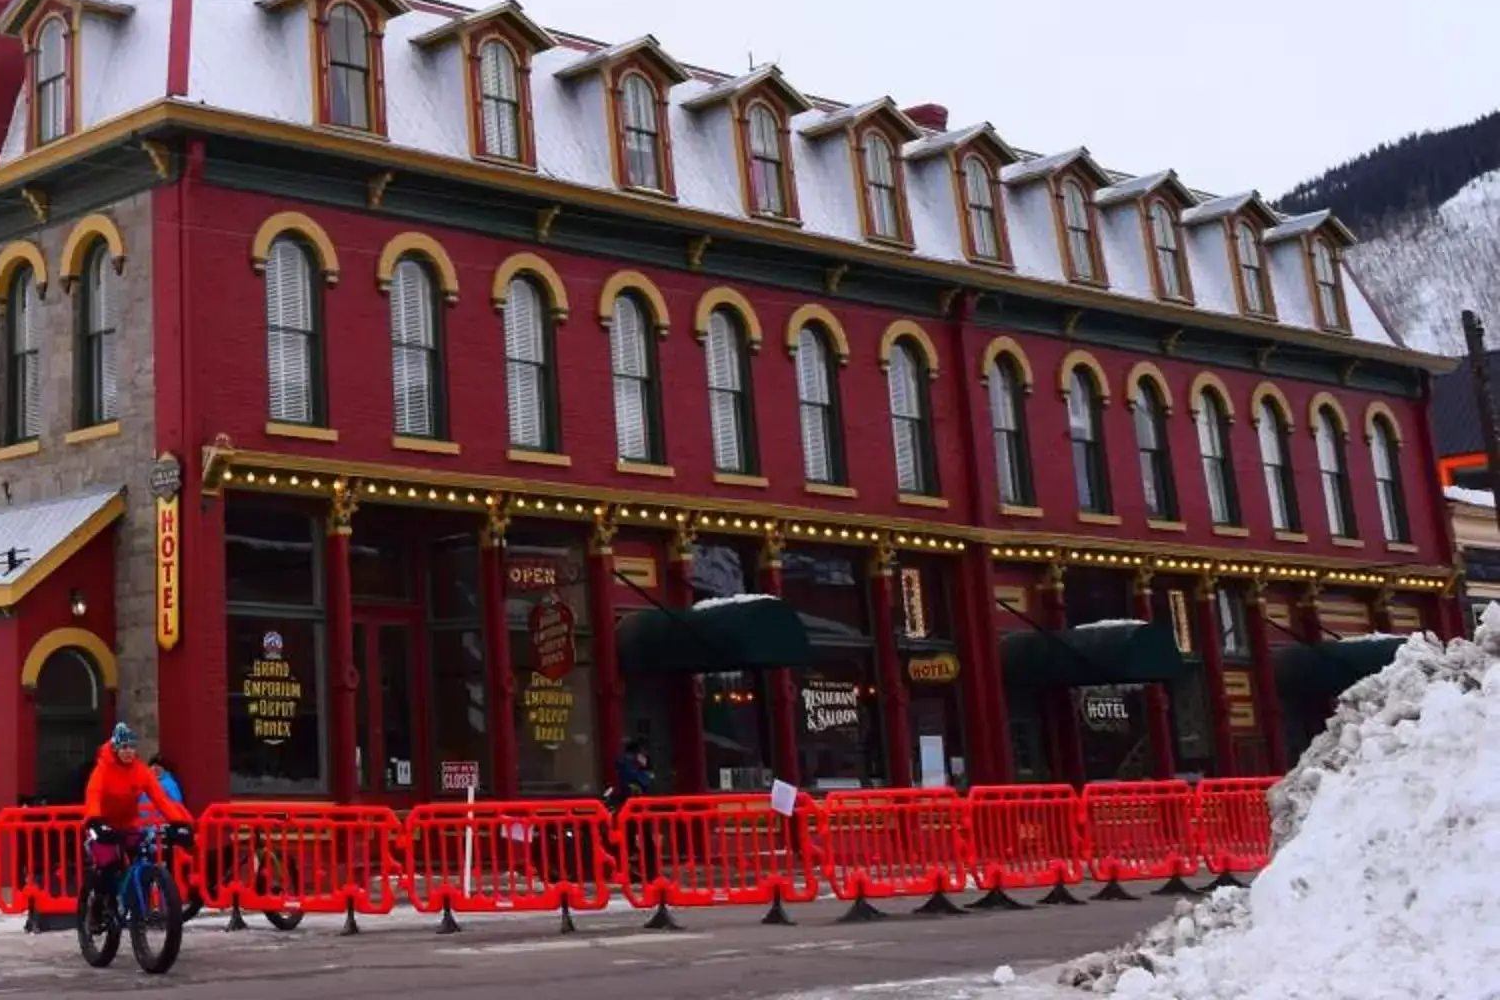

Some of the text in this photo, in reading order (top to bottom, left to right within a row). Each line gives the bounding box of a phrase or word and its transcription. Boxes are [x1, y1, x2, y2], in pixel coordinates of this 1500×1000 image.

[161, 509, 175, 636] HOTEL
[509, 567, 557, 585] OPEN
[912, 662, 953, 678] HOTEL
[243, 679, 301, 697] EMPORIUM
[260, 699, 296, 717] DEPOT
[802, 688, 857, 710] RESTAURANT
[1087, 700, 1129, 719] HOTEL
[817, 707, 859, 732] SALOON
[444, 773, 477, 788] CLOSED
